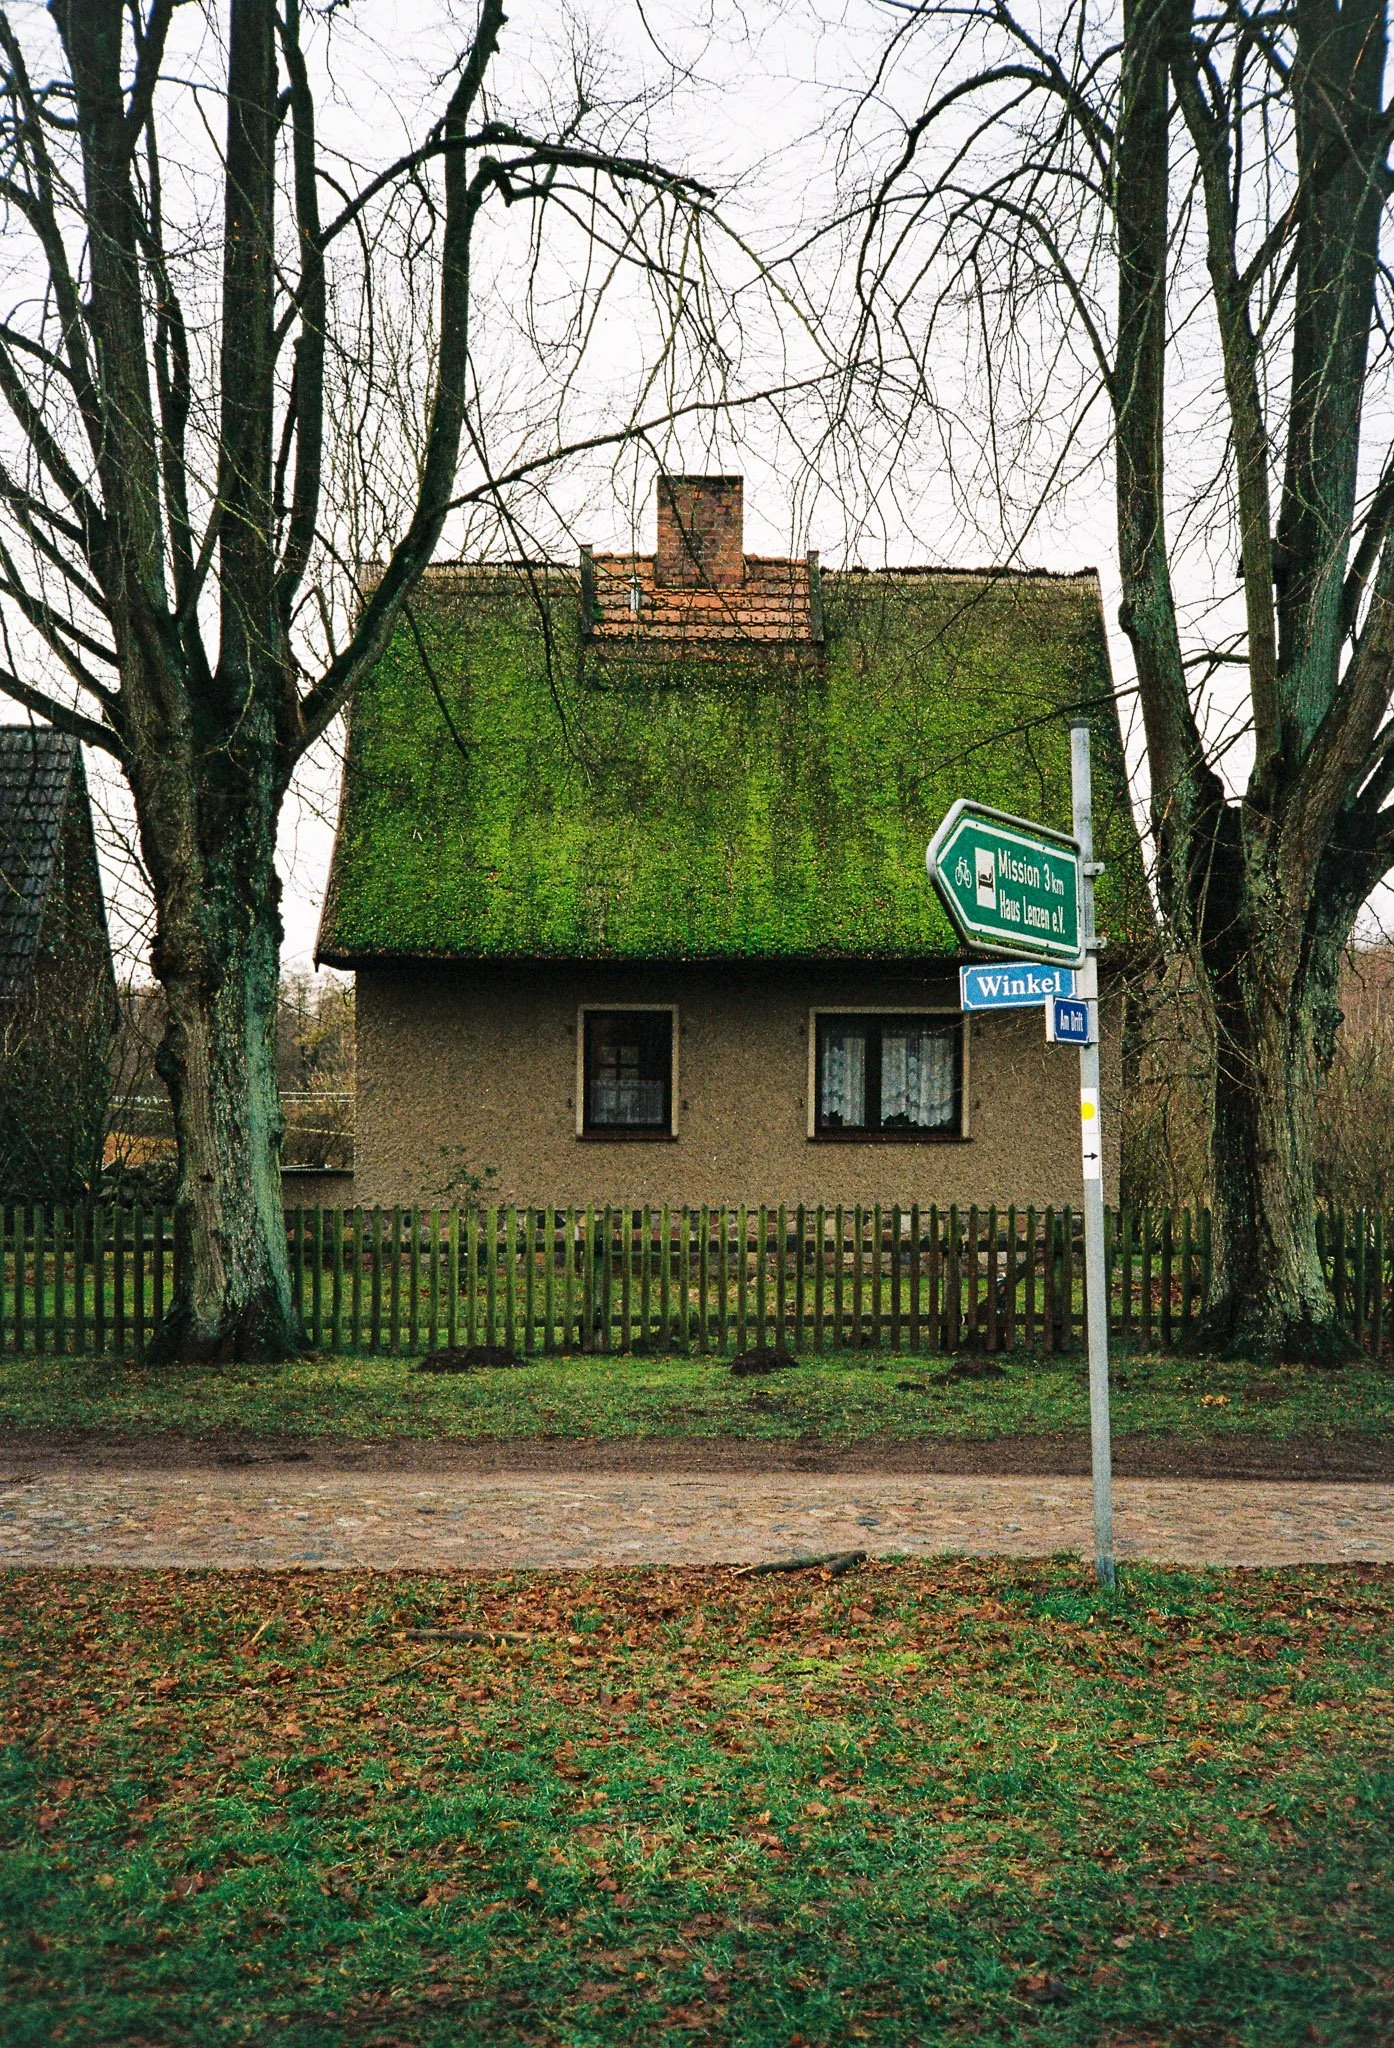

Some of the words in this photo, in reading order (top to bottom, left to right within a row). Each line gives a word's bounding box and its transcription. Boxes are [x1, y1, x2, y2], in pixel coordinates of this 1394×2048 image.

[998, 847, 1040, 889] Mission
[1043, 863, 1050, 891] 3
[1052, 872, 1064, 895] km
[999, 889, 1021, 922] Haus
[1023, 896, 1050, 930] Lenzen
[977, 971, 1062, 997] Winkel
